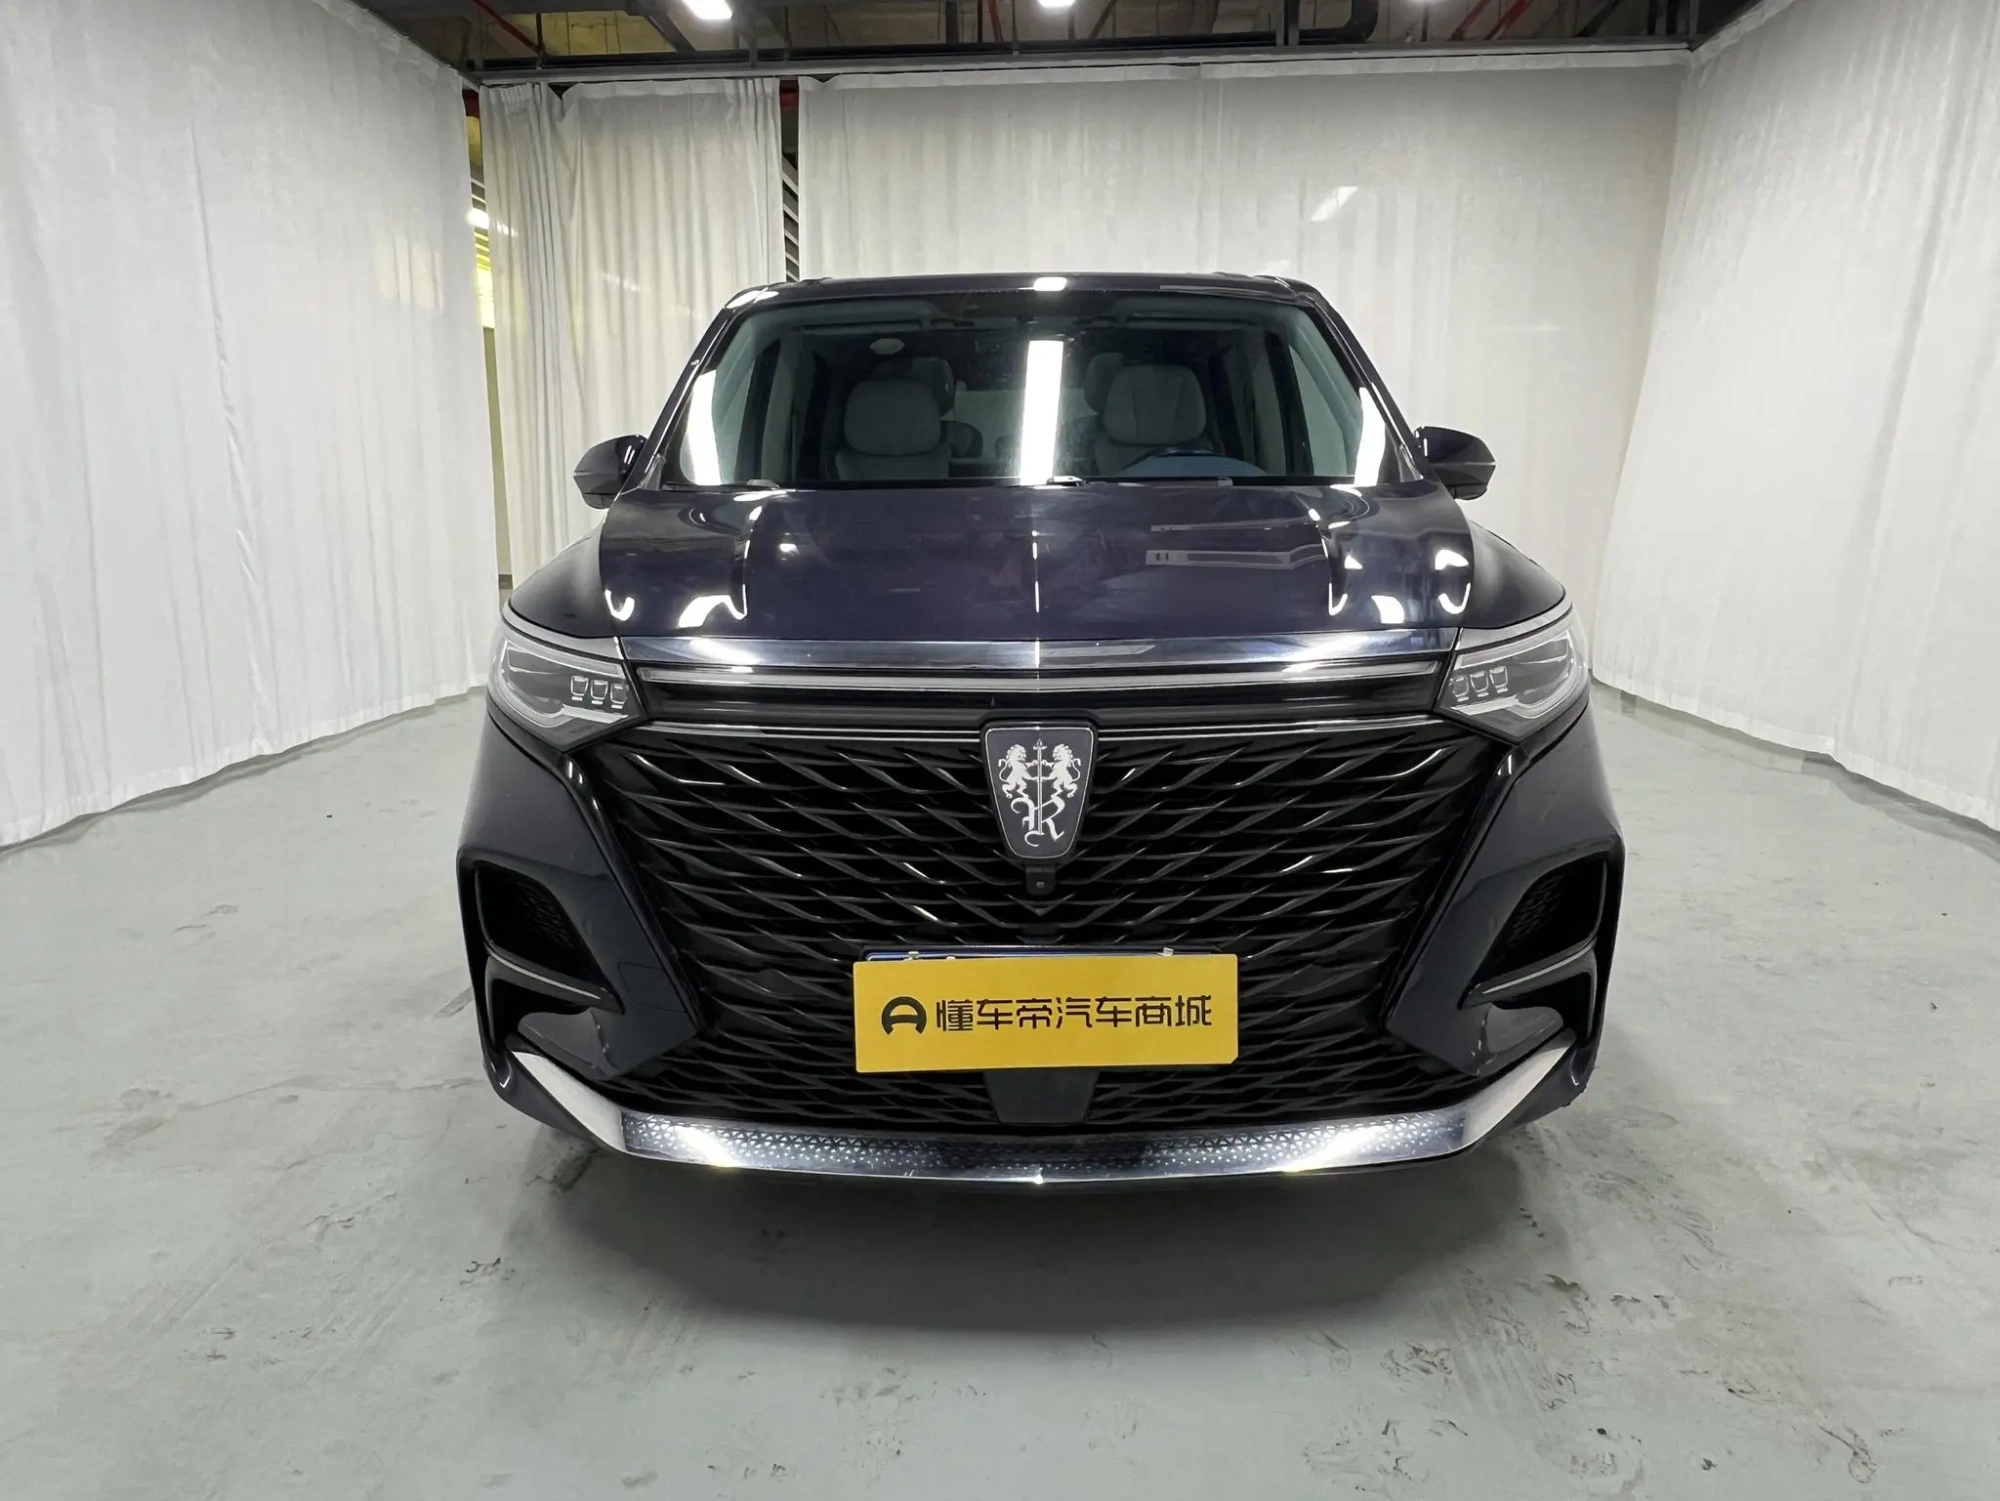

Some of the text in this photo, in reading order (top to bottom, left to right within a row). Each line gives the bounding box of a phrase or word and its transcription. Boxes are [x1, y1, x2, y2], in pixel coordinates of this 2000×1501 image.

[936, 994, 1213, 1032] 懂车帝汽车商城
